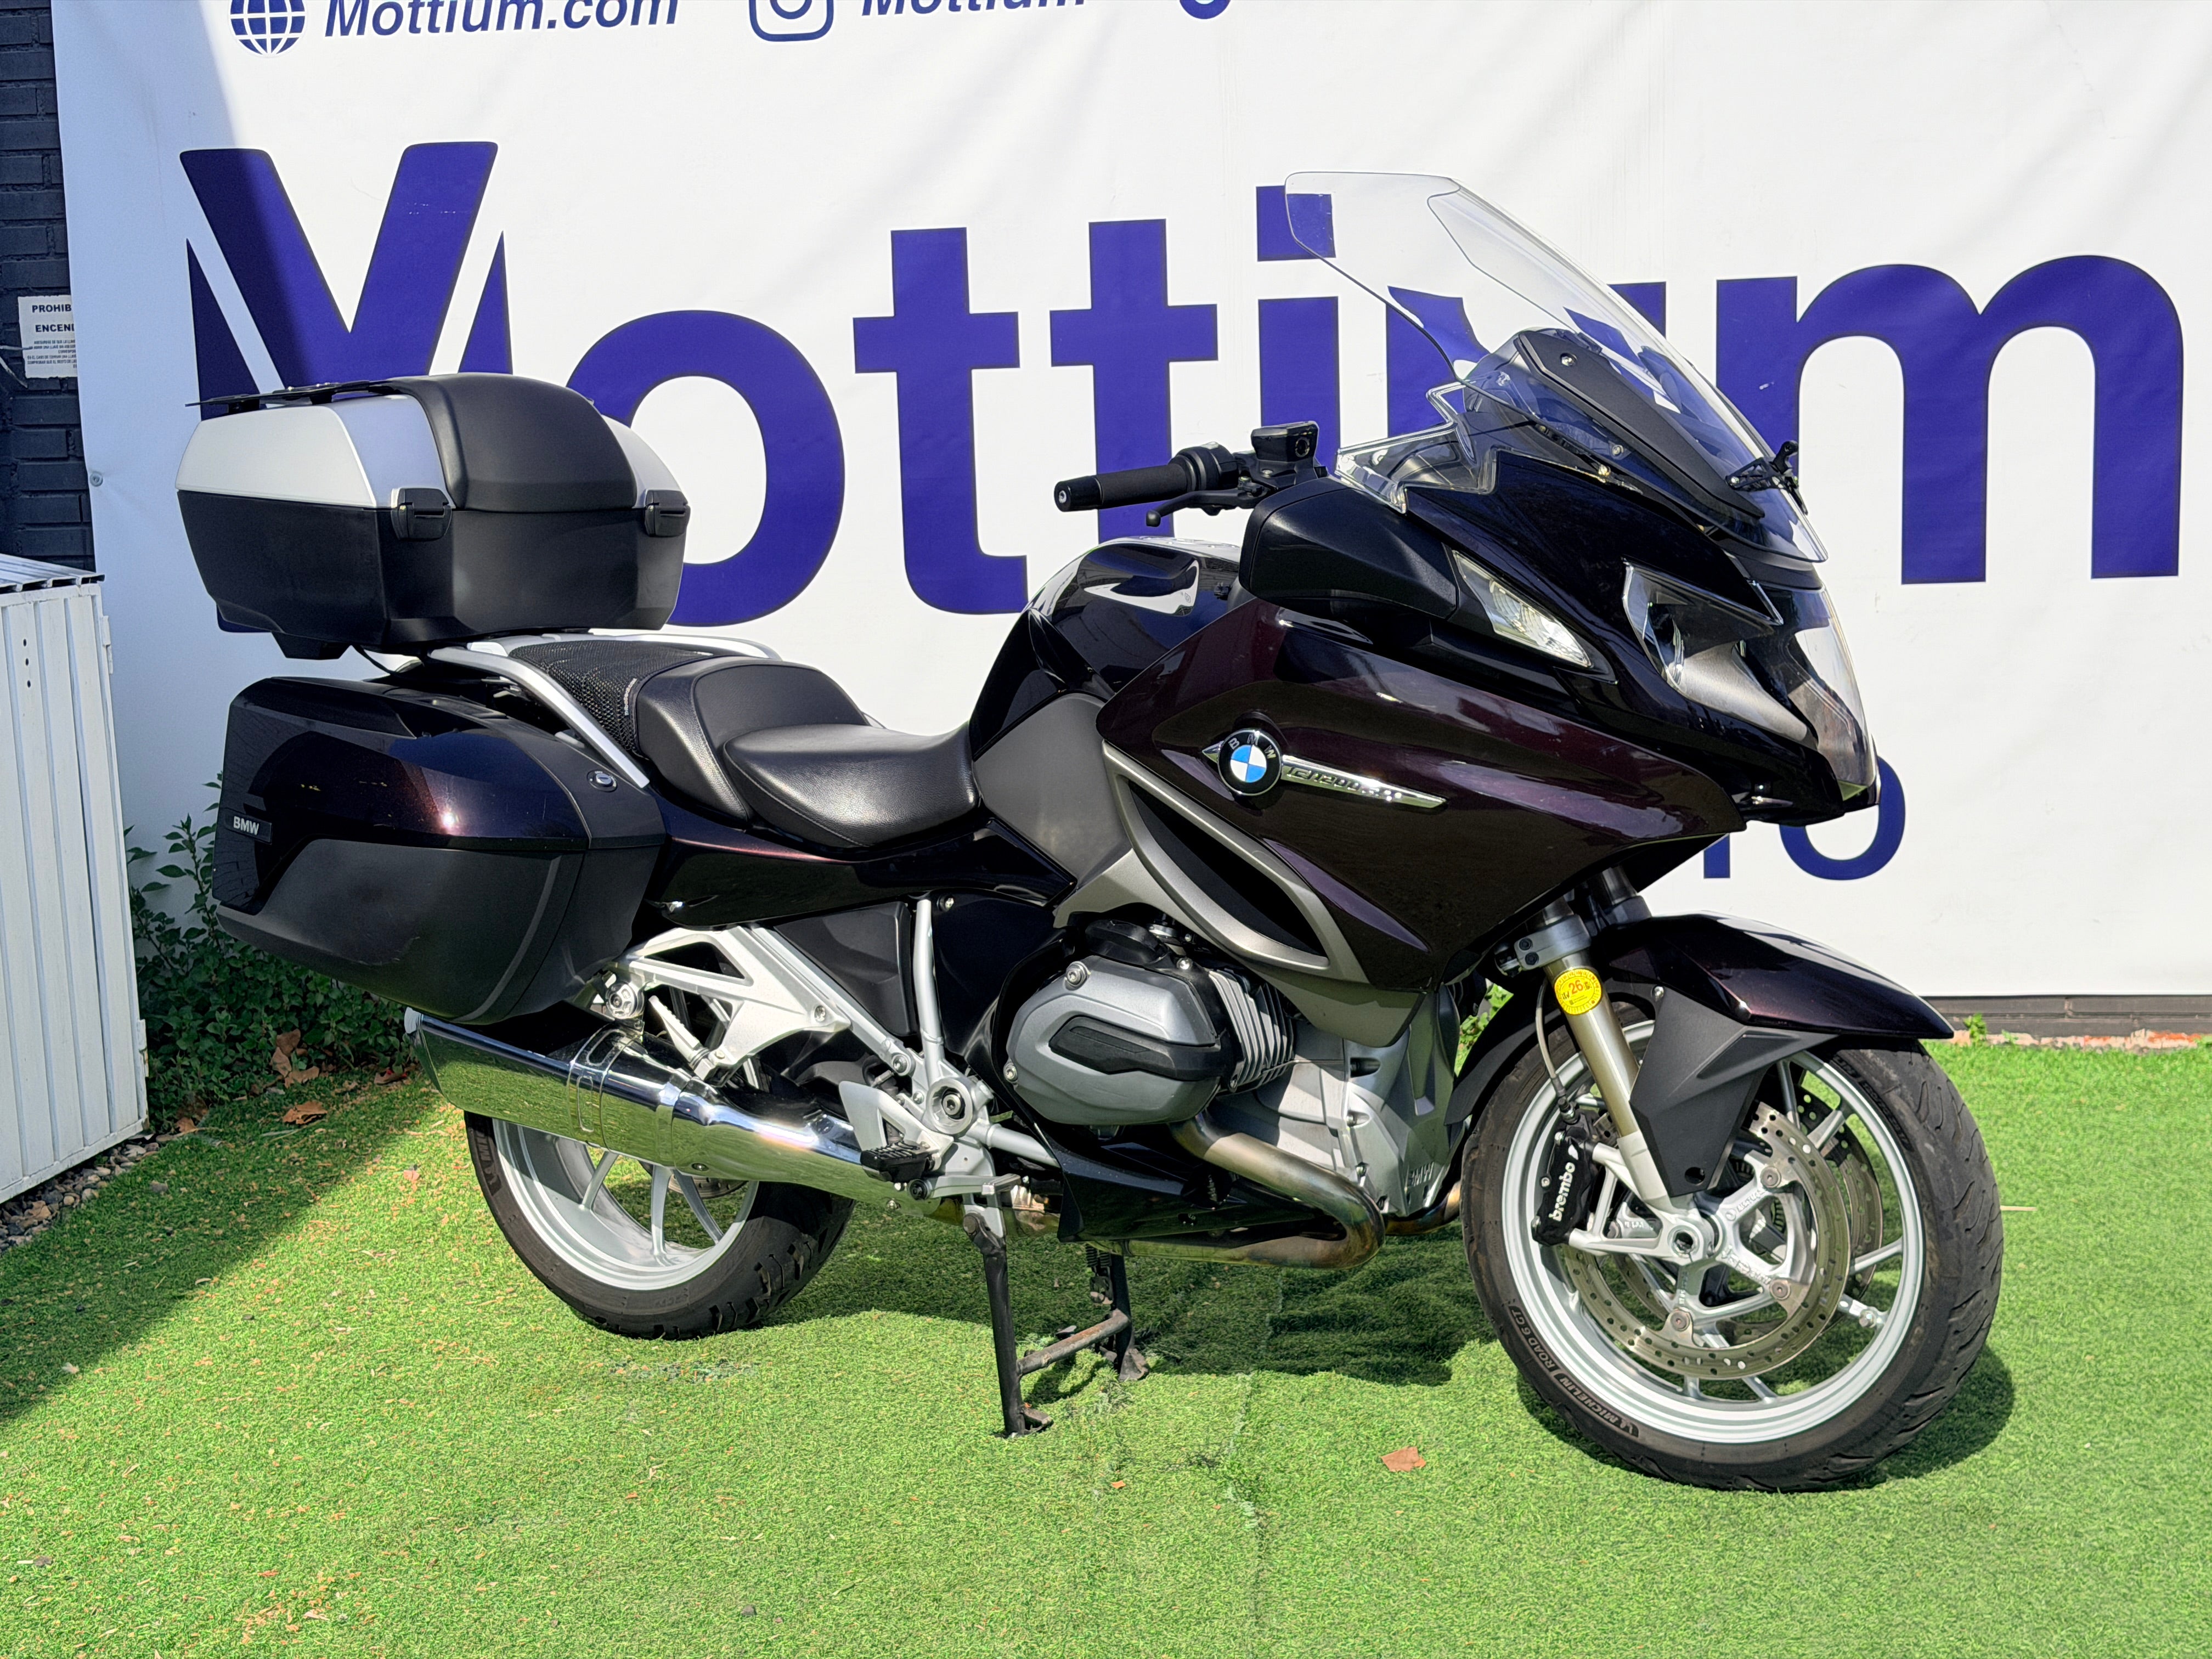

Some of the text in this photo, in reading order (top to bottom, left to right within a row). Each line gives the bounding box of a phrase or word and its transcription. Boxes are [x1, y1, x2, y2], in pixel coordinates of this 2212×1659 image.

[325, 0, 679, 37] Mottium.com
[1228, 733, 1277, 759] BMW
[234, 816, 259, 835] BMW
[1568, 980, 1583, 995] 26
[1549, 1162, 1576, 1222] brembo
[1511, 1310, 1619, 1423] MICHELIN ROAD 6 GT
